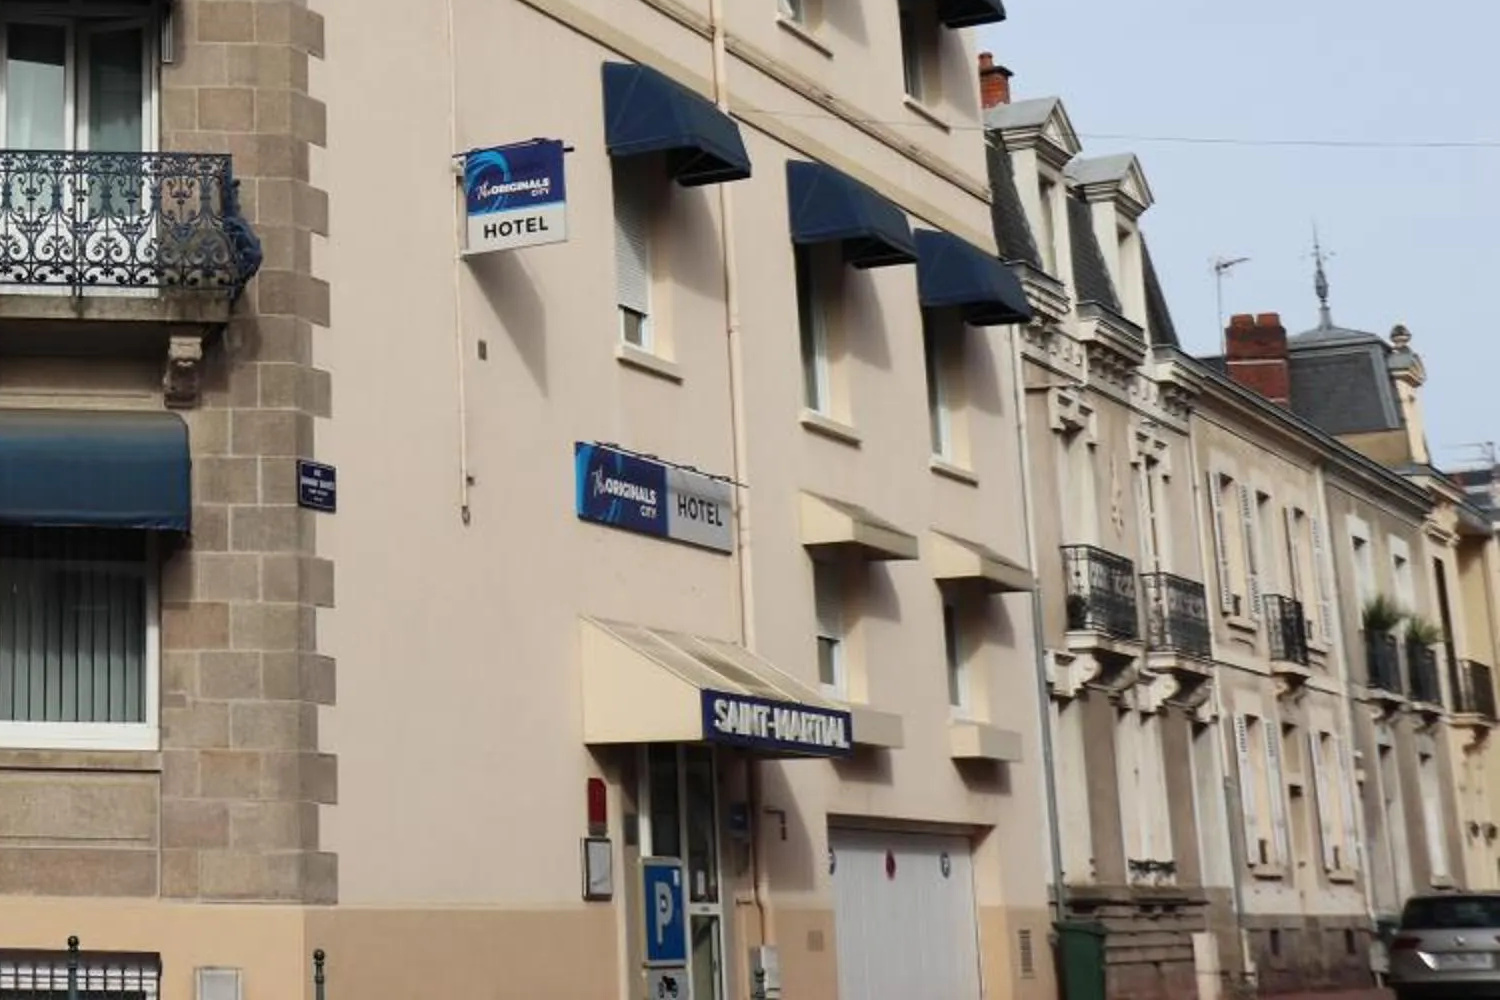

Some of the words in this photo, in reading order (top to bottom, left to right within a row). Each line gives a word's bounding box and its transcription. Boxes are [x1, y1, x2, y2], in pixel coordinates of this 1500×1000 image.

[490, 177, 550, 194] ORIGINALS
[483, 216, 549, 239] HOTEL
[604, 476, 657, 505] ORIGINALS
[638, 505, 657, 519] CITY
[676, 493, 723, 527] HOTEL
[713, 698, 850, 749] SAINT-MARTIAL
[654, 880, 674, 946] P
